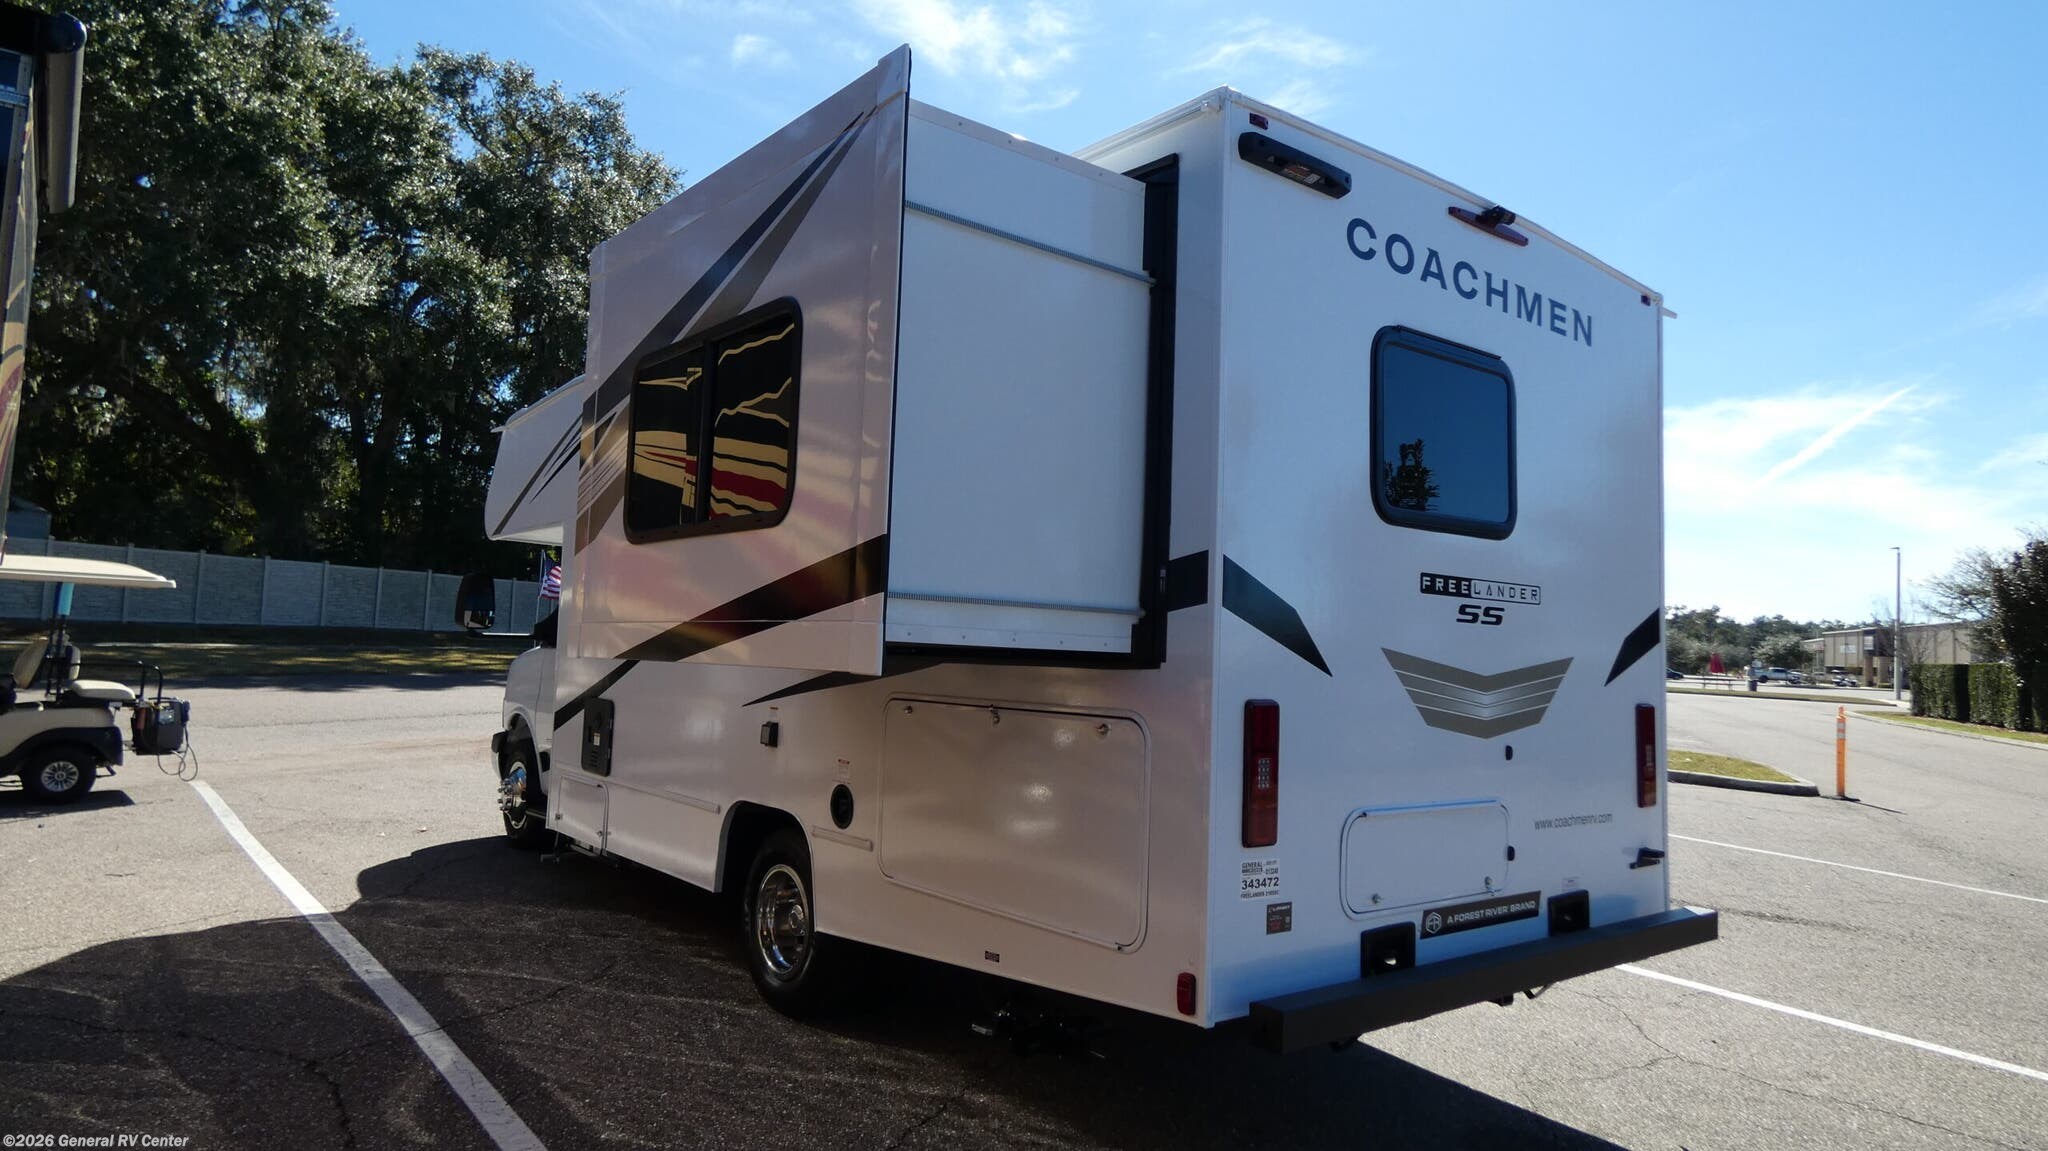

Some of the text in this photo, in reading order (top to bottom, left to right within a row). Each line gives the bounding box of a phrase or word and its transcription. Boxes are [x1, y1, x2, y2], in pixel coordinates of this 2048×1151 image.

[1346, 217, 1593, 347] COACHMEN
[1422, 576, 1538, 601] FREELANDER
[1456, 604, 1505, 626] SS
[1241, 877, 1280, 890] 343472
[1447, 900, 1536, 925] A FOREST RIVER BRAND
